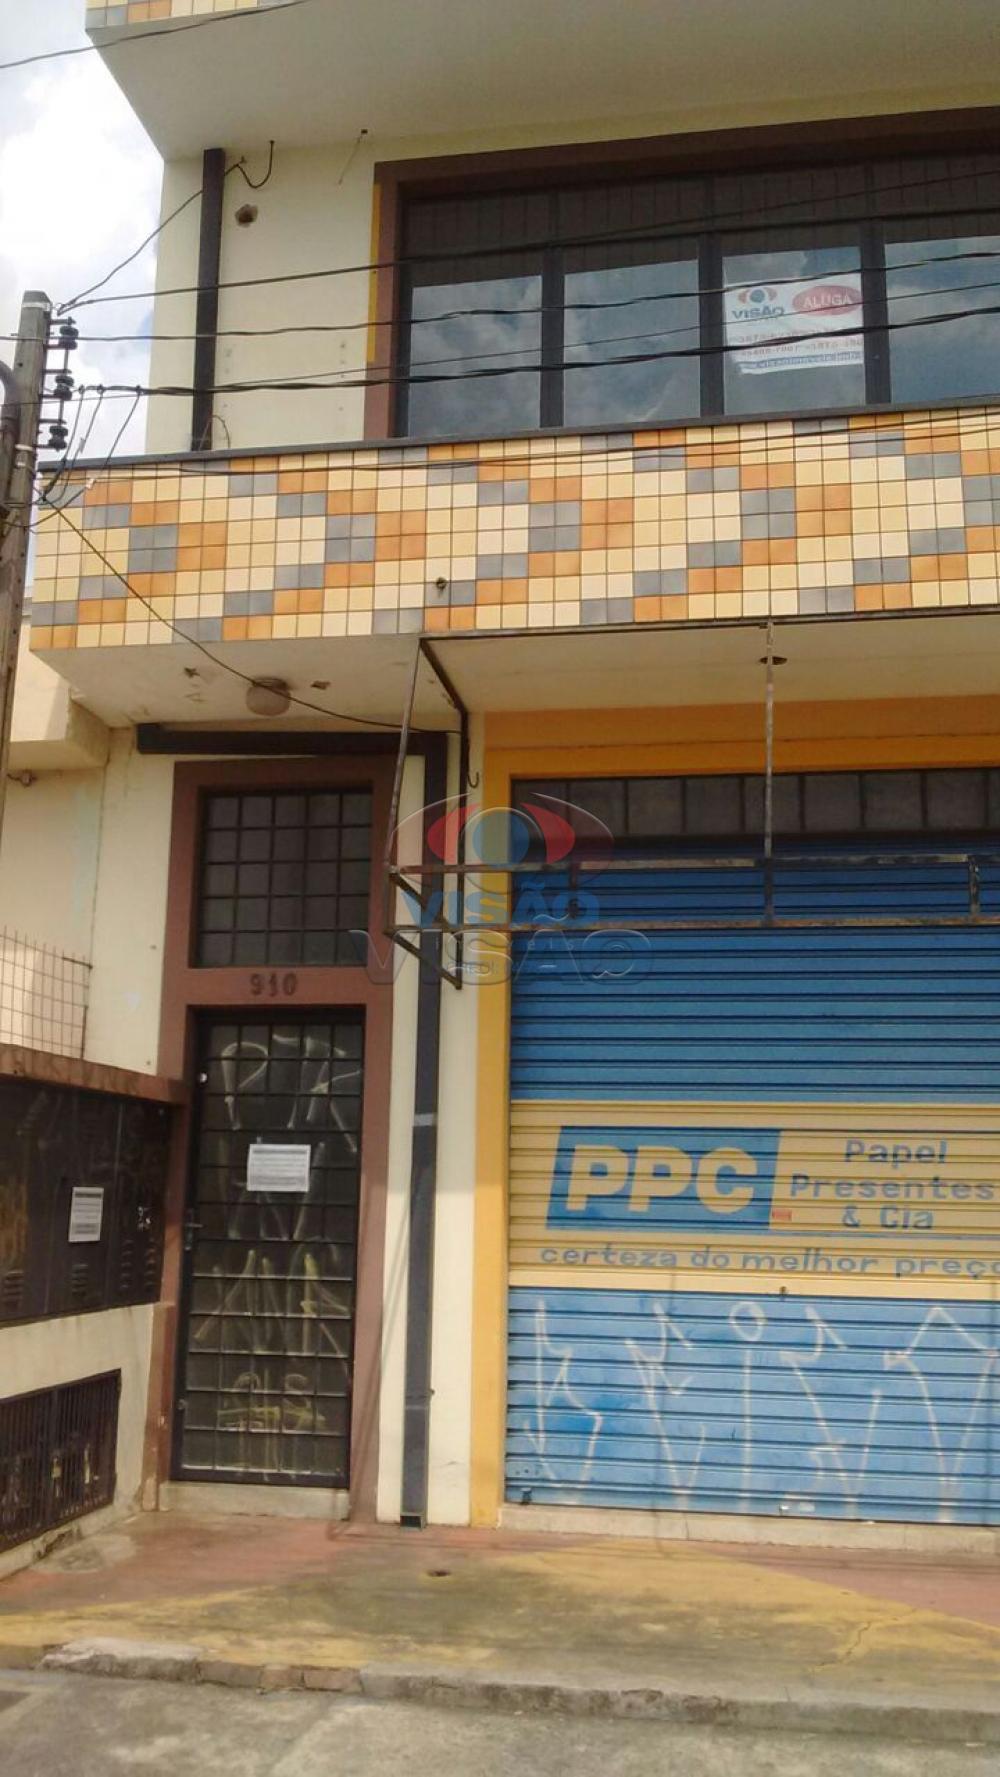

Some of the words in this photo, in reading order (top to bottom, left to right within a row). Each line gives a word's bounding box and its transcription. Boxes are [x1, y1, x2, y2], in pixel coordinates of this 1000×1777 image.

[732, 304, 785, 319] VISÃO
[803, 292, 851, 309] ALUGA
[250, 973, 298, 997] 910
[844, 1139, 948, 1168] Papel
[565, 1144, 758, 1213] PPC
[789, 1174, 995, 1201] Presentes
[841, 1205, 861, 1229] &
[879, 1204, 934, 1230] Cia
[540, 1243, 677, 1268] certeza
[690, 1245, 730, 1270] do
[741, 1248, 879, 1274] melhor
